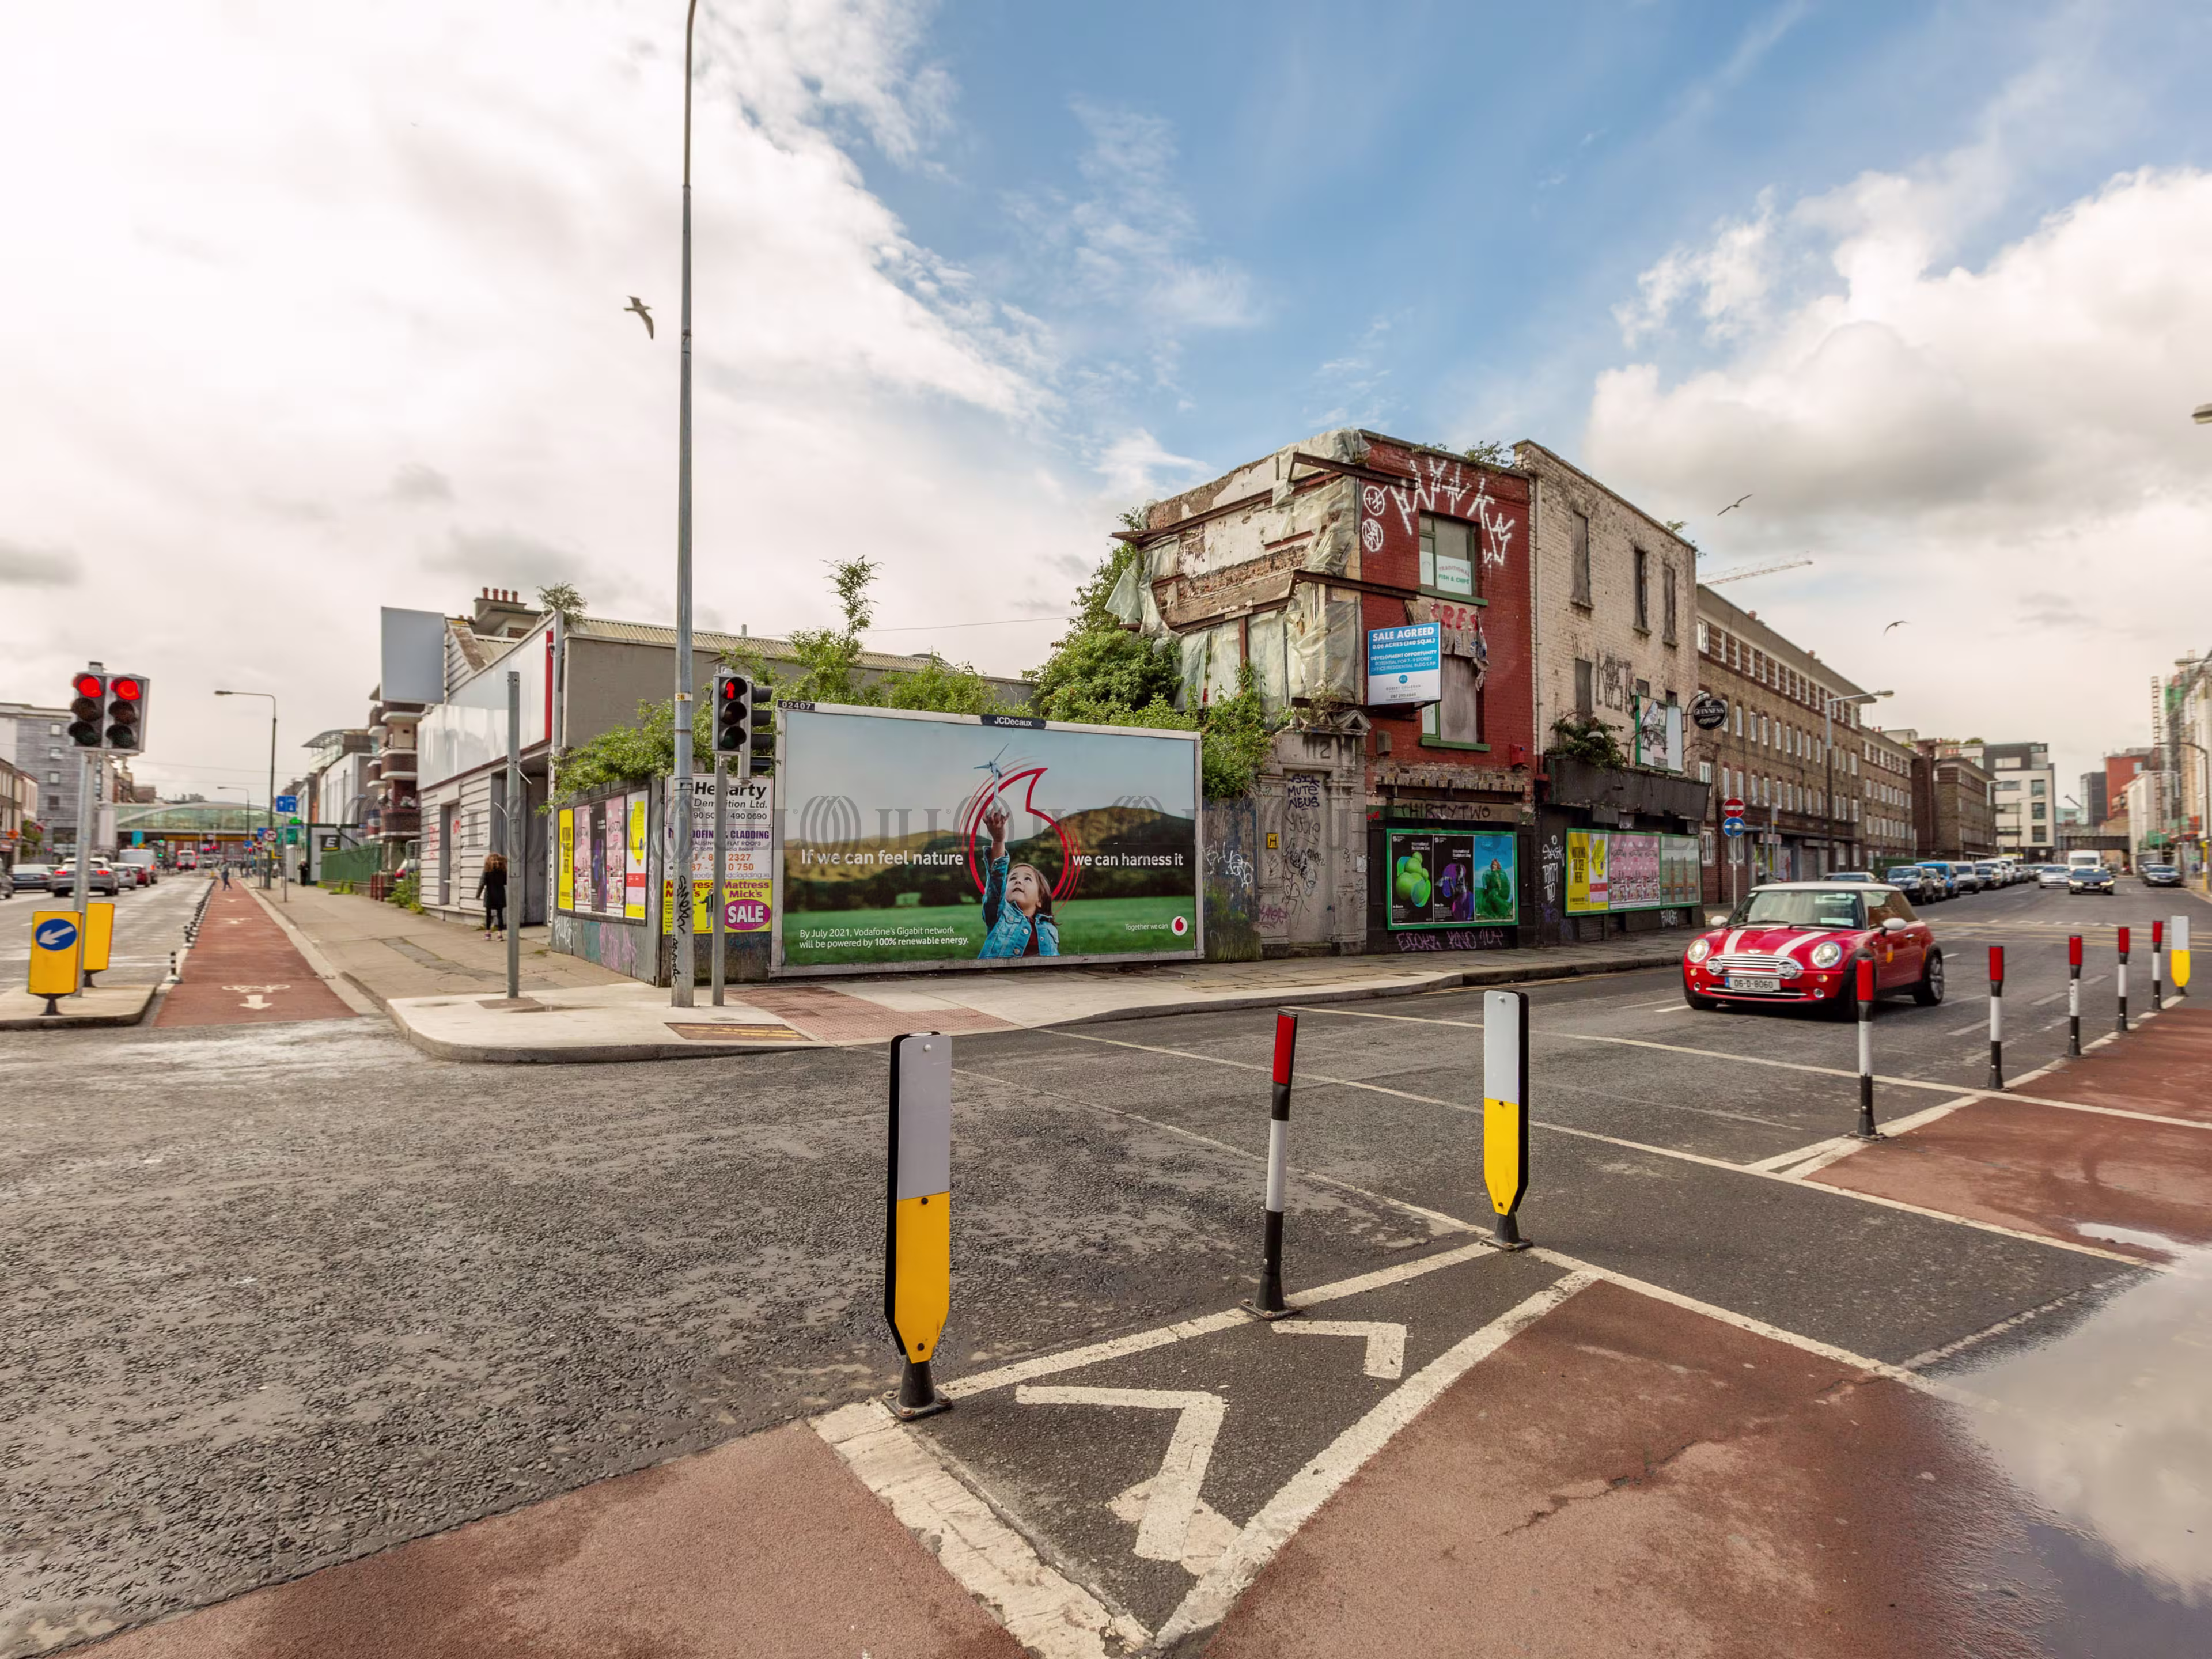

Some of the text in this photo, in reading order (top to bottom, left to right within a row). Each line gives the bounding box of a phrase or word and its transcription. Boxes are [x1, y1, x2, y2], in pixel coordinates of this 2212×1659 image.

[1373, 627, 1434, 641] SALE AGREED
[782, 701, 811, 710] 02407
[994, 717, 1032, 726] JCDecaux
[695, 782, 767, 800] Hearty
[694, 798, 767, 808] Demition Ltd.
[730, 830, 769, 839] CLADDING
[1269, 836, 1277, 846] H
[801, 849, 964, 865] If we can feel nature
[1073, 853, 1183, 866] we can harness it
[729, 889, 762, 898] Mick's
[728, 905, 764, 924] SALE
[800, 929, 809, 940] By
[811, 929, 828, 939] July
[853, 927, 896, 937] Vodafone's
[897, 926, 923, 937] Gigabit
[925, 926, 955, 935] network
[1125, 923, 1149, 932] Together
[800, 937, 969, 949] will be powered by 100% renewable energy.
